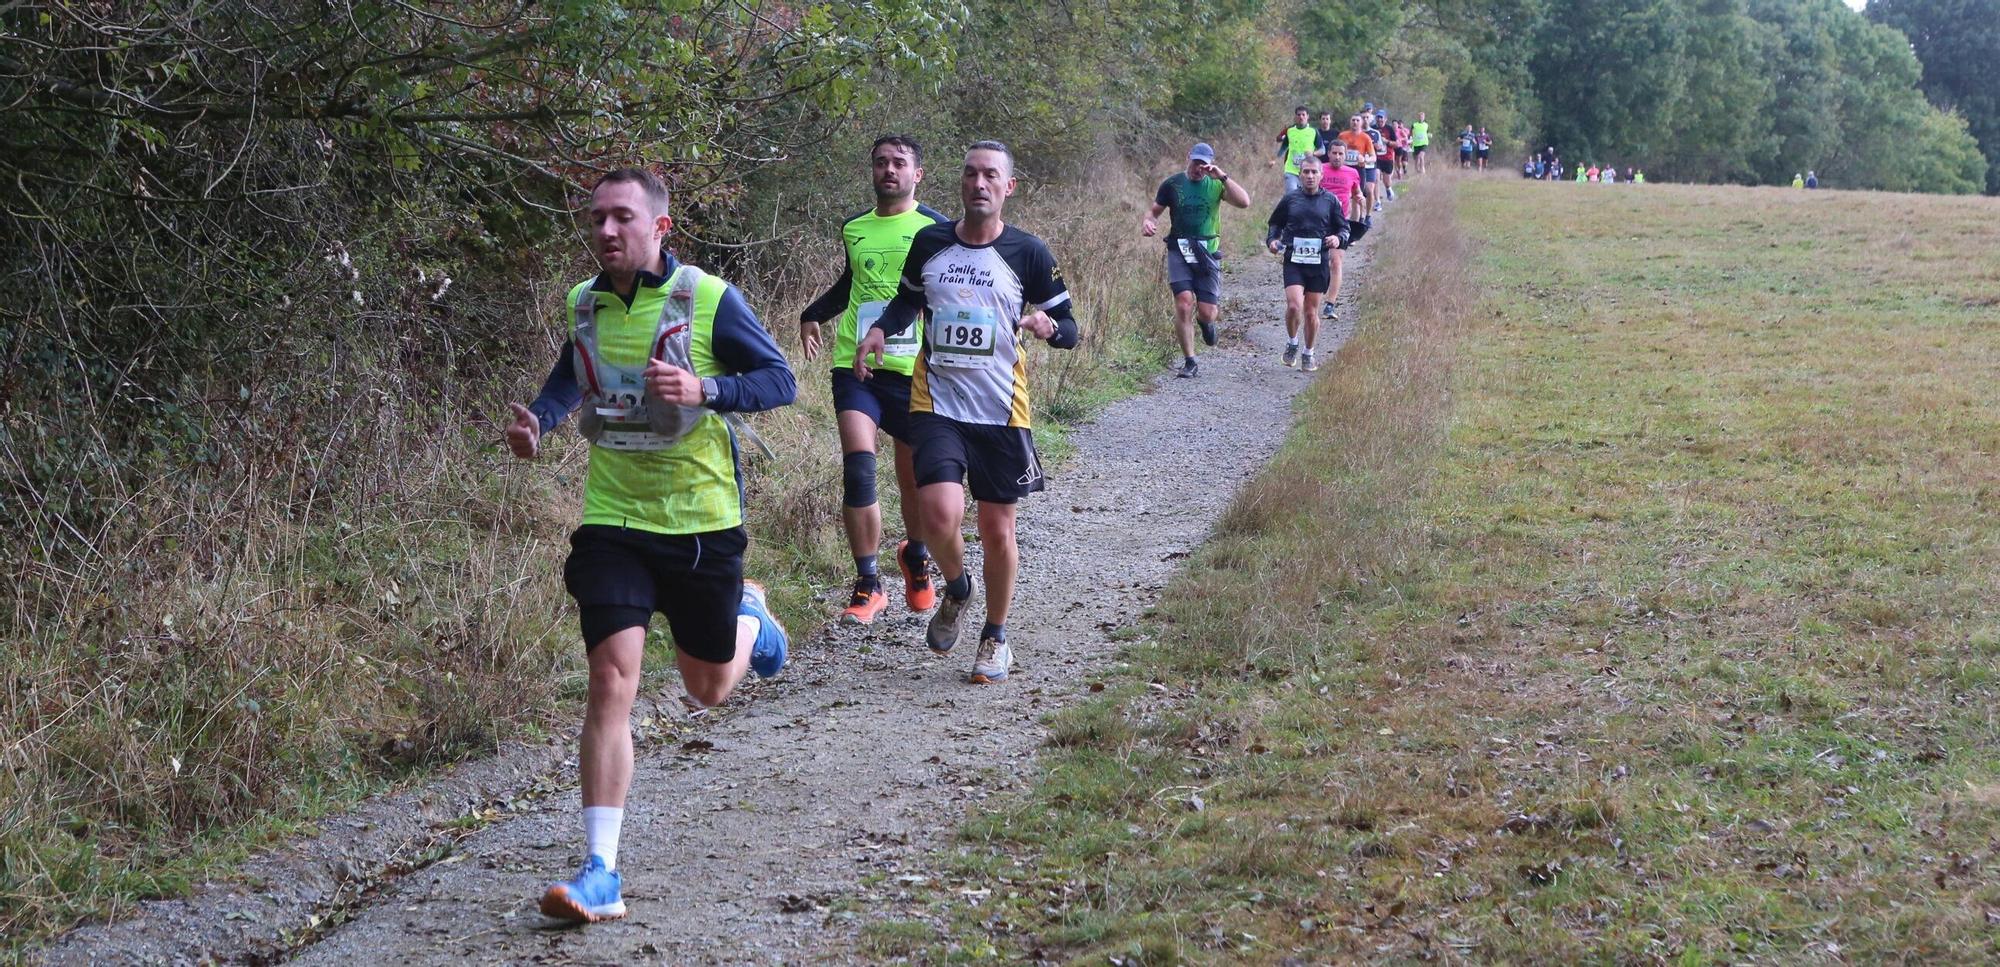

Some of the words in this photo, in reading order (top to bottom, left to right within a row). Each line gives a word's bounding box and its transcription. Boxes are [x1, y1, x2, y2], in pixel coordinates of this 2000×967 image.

[947, 263, 976, 275] Smile
[938, 272, 965, 285] Train
[968, 274, 995, 288] Hard
[944, 324, 983, 347] 198
